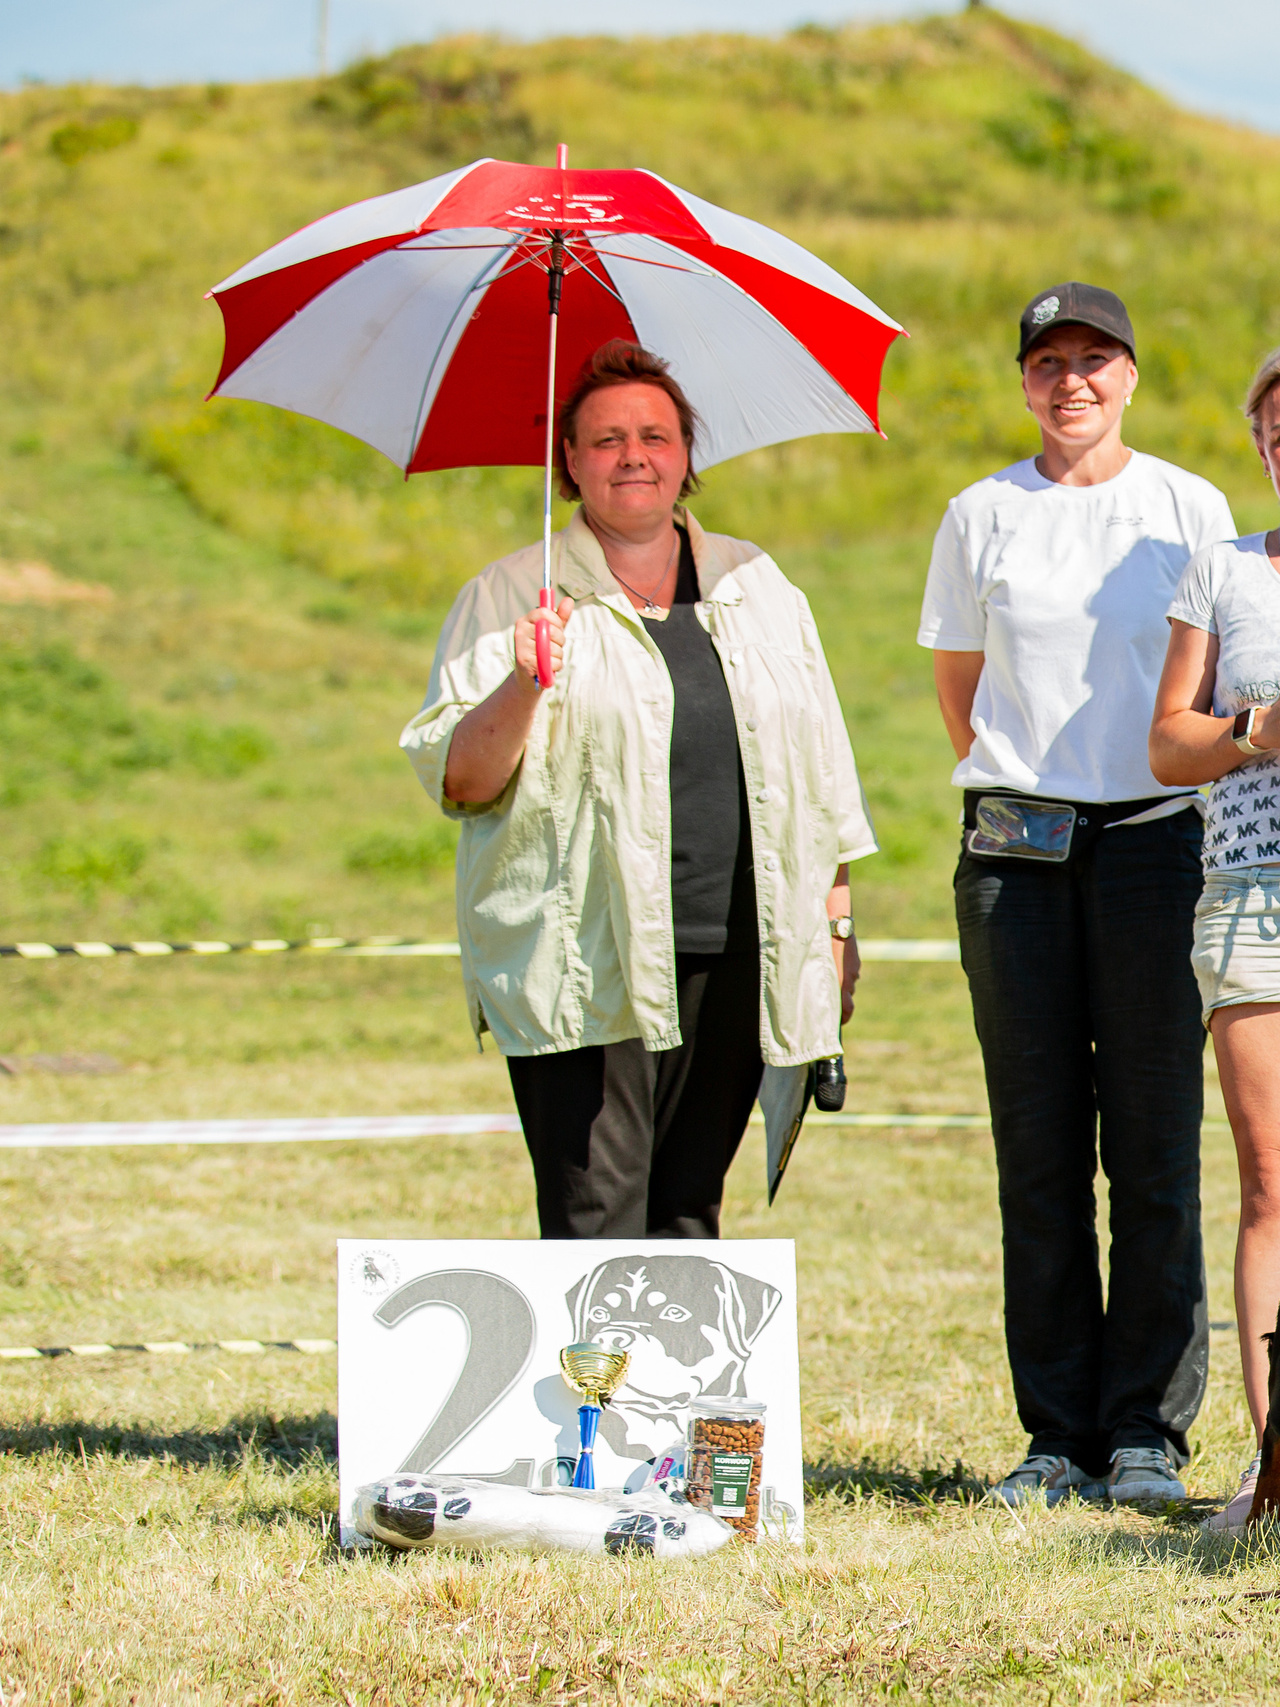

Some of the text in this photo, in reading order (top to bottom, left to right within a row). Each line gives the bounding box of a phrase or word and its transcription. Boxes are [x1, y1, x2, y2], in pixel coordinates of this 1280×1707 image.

[1238, 779, 1262, 796] MK
[1222, 802, 1245, 820] MK
[1253, 795, 1278, 812] MK
[1236, 820, 1262, 840] MK
[1225, 846, 1249, 865] MK
[373, 1268, 537, 1488] 2
